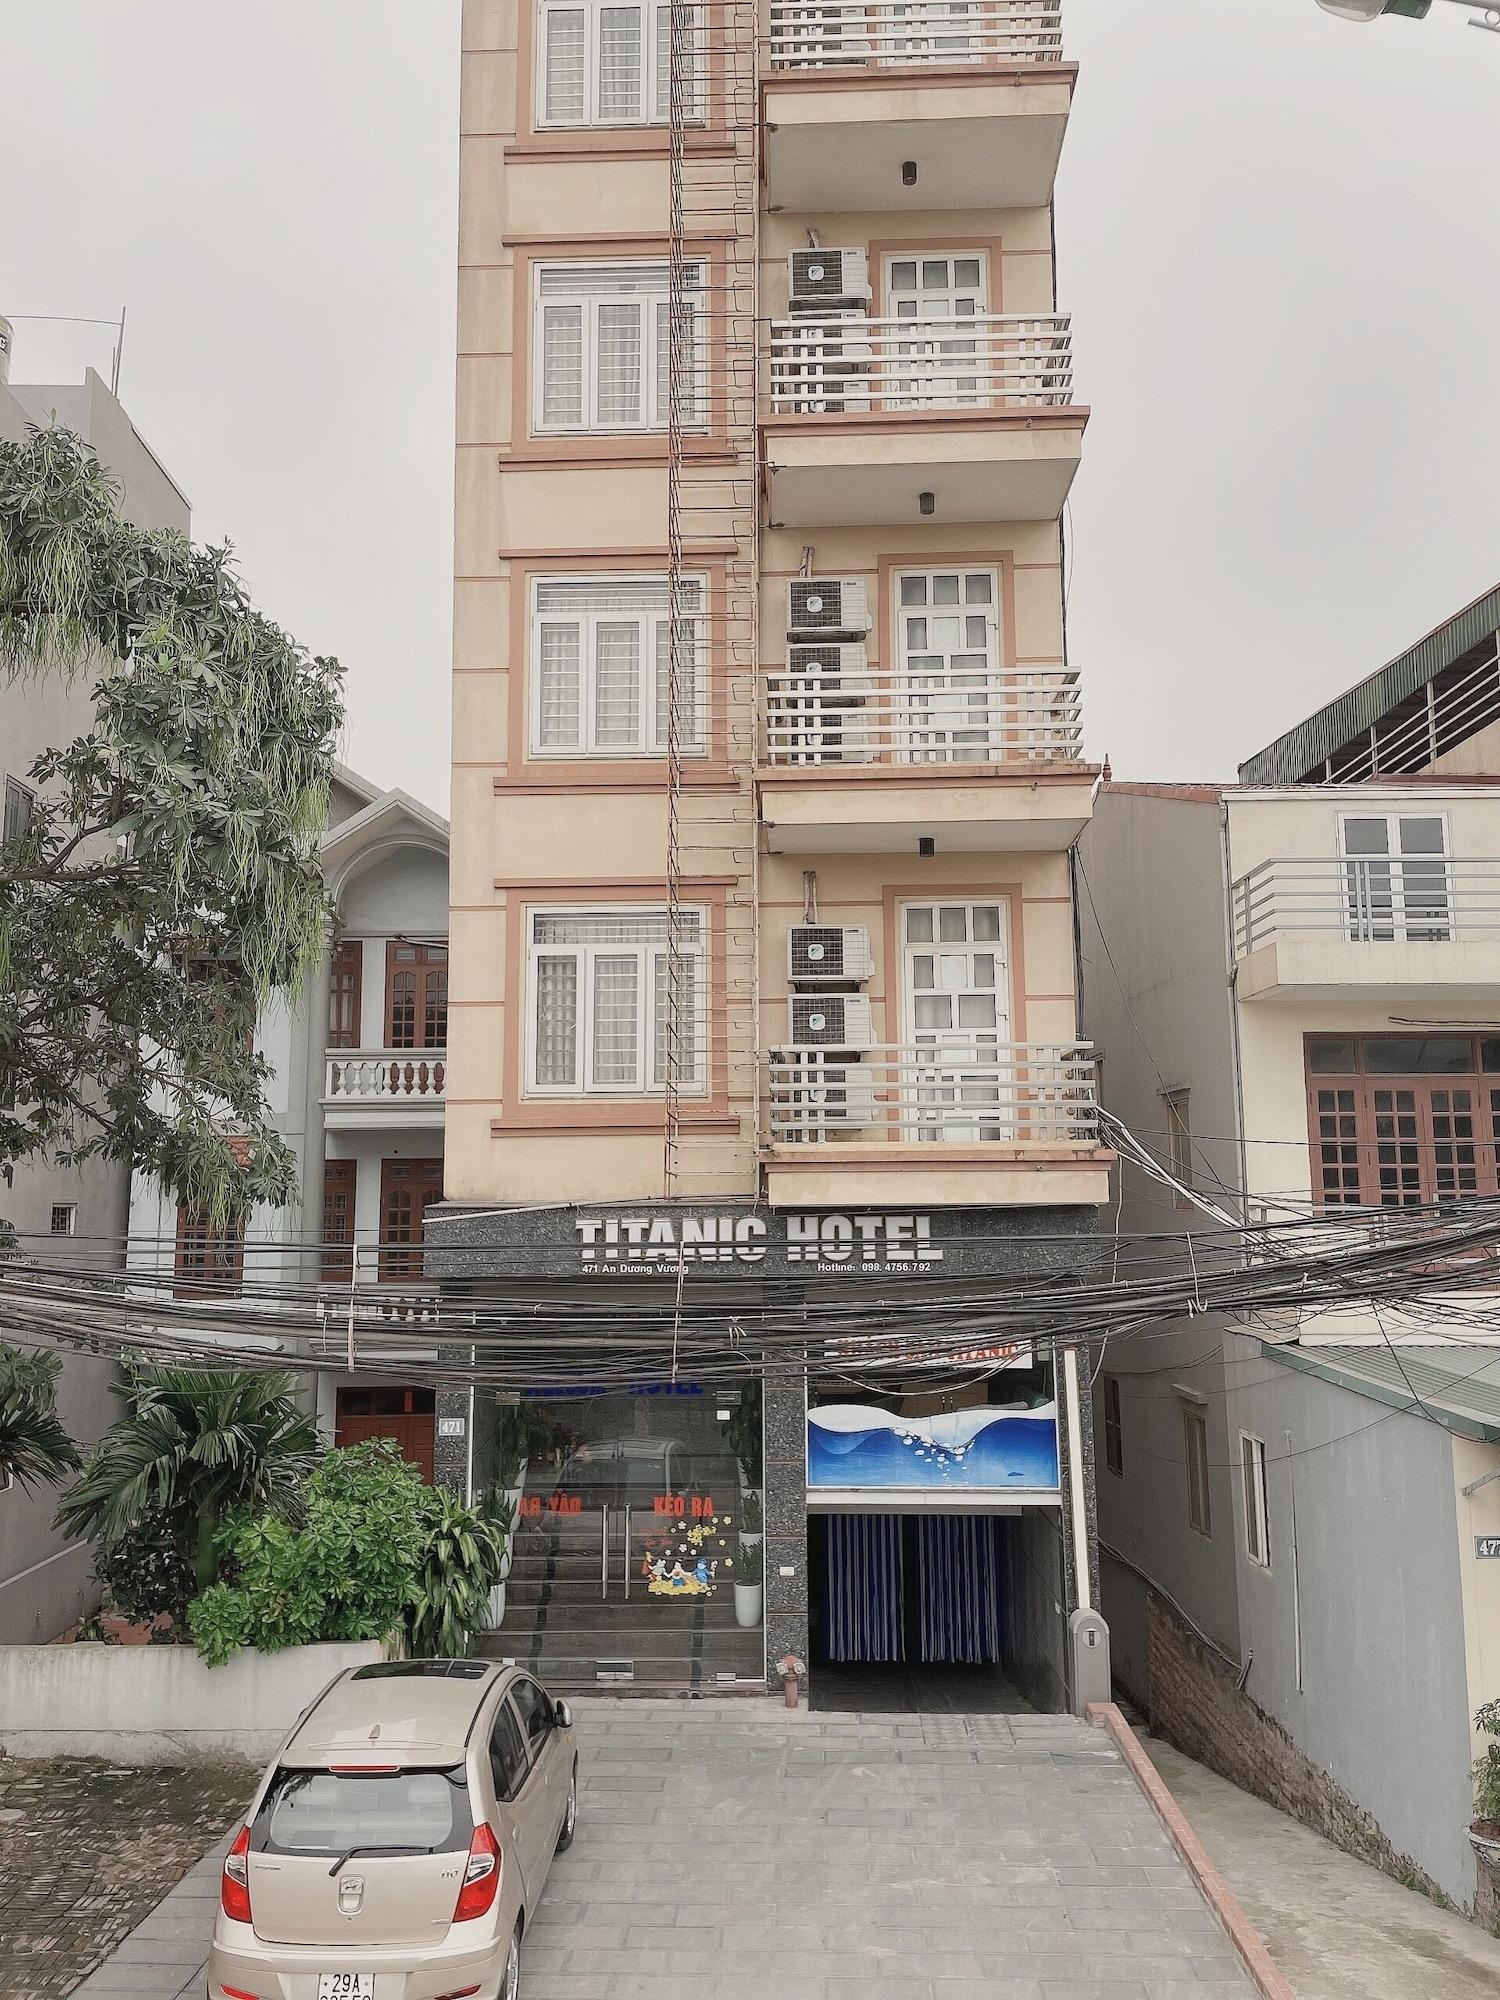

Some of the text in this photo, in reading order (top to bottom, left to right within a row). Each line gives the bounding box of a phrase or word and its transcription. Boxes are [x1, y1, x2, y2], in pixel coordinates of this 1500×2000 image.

[575, 1215, 944, 1262] TITANIC HOTEL
[582, 1264, 599, 1274] 471
[602, 1264, 617, 1274] An
[620, 1264, 653, 1276] Dương
[442, 1421, 460, 1433] 471
[691, 1496, 714, 1517] RA
[332, 1973, 361, 1993] 29A
